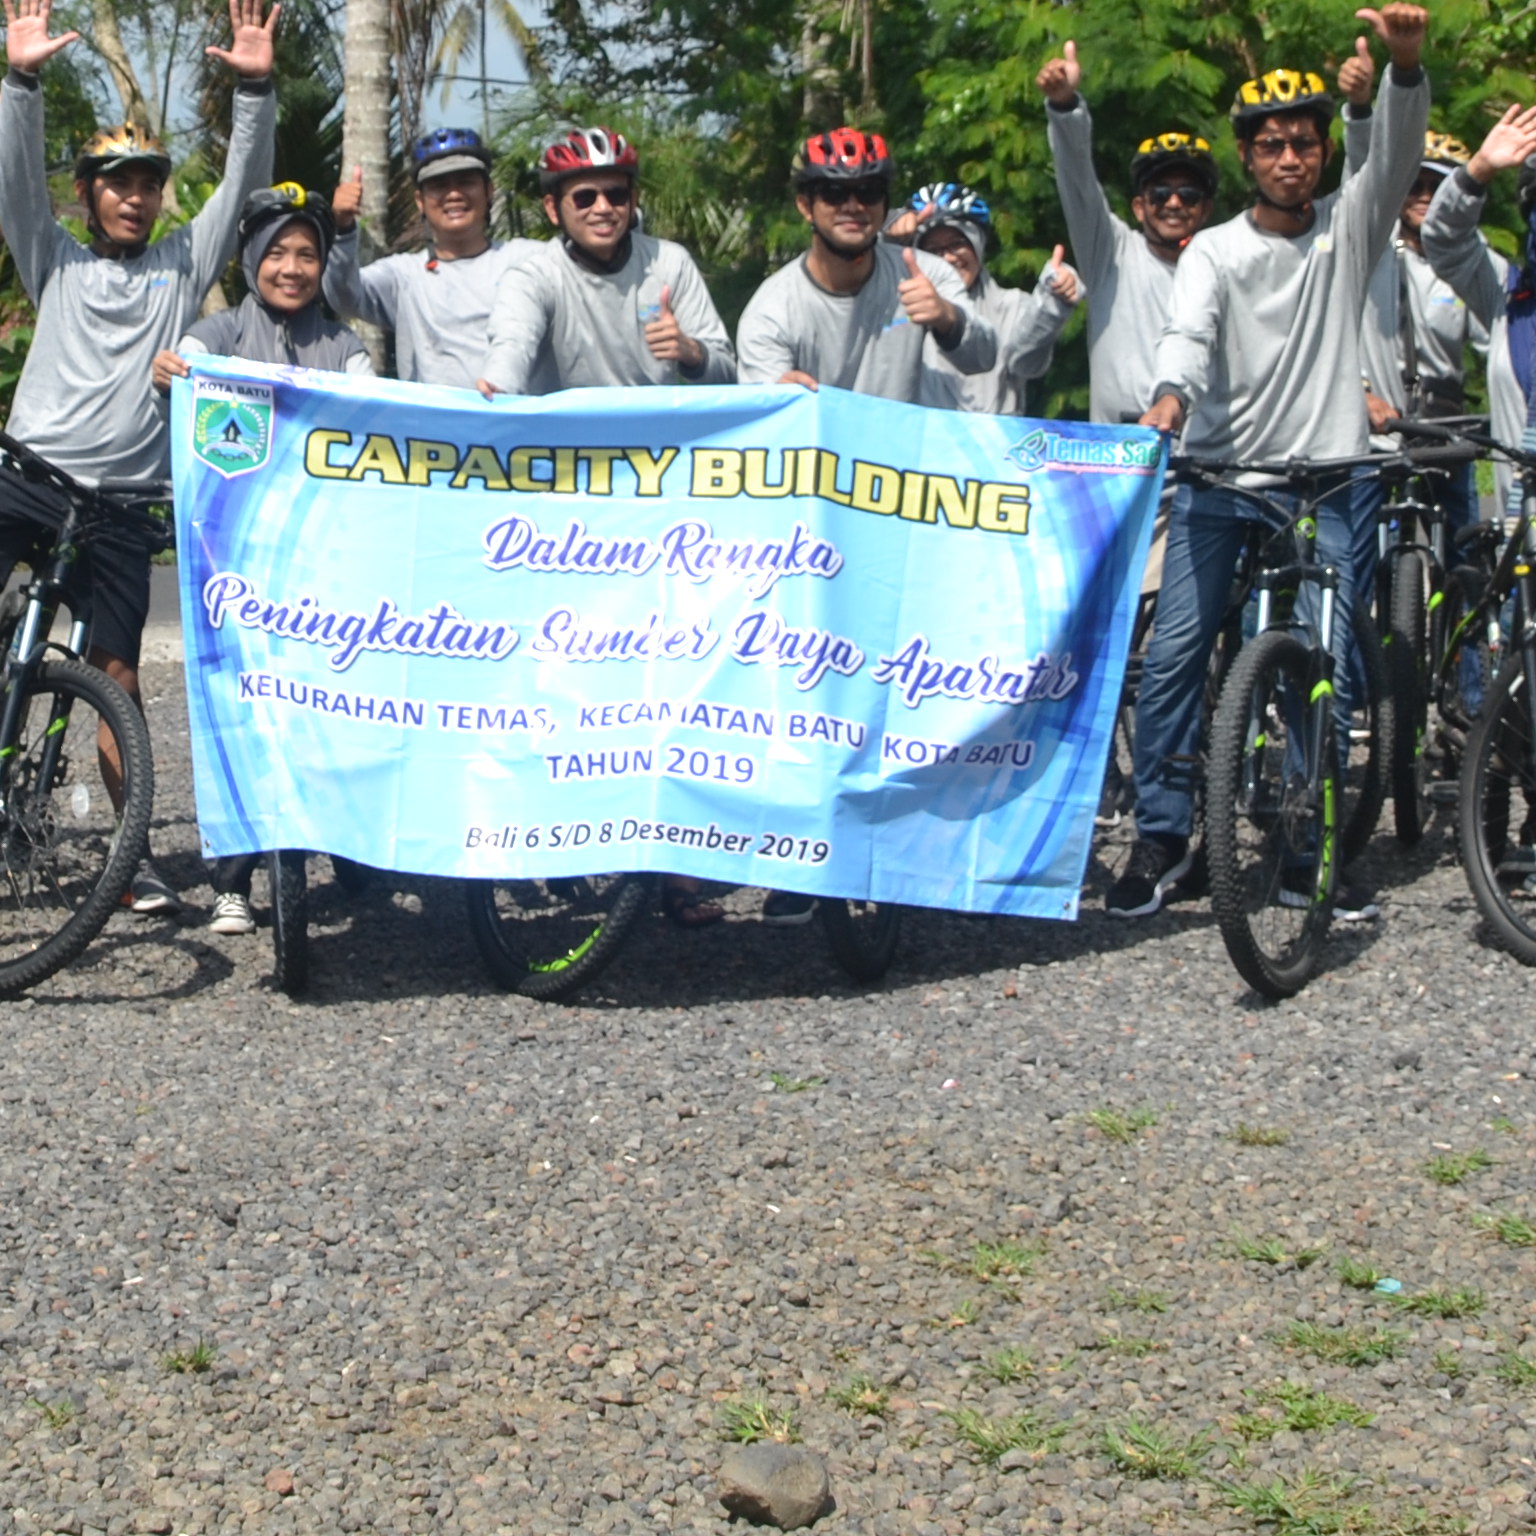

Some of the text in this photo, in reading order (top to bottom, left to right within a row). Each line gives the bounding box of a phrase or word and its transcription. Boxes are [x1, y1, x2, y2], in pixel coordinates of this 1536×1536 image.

[198, 381, 270, 399] KOTA BATU
[1044, 431, 1160, 467] Temas Sae
[304, 428, 1031, 535] CAPACITY BUILDING
[484, 515, 842, 598] Dalam Rangka
[206, 575, 1077, 703] Peningkatan Sumber Daya Aparatur
[239, 673, 1032, 766] KELURAHAN TEMAS, KECAMATAN BATU KOTA BATU
[546, 747, 754, 783] TAHUN 2019
[465, 819, 829, 863] Bali 6 S/D 8 Desember 2019
